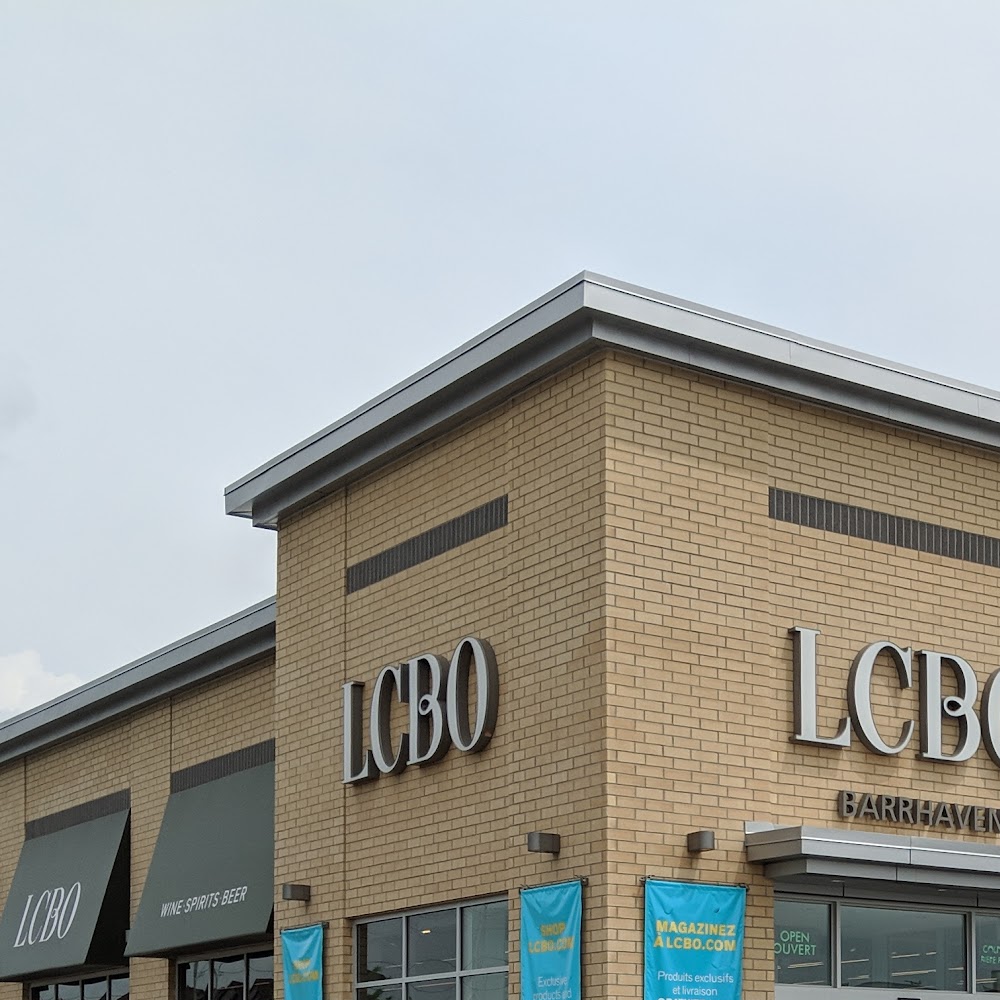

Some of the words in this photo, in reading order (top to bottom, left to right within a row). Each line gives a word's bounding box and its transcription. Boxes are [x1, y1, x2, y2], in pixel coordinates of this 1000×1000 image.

[341, 636, 499, 785] LCBO
[13, 881, 81, 948] LCBO
[541, 922, 566, 936] SHOP
[655, 919, 736, 936] MAGAZINEZ
[653, 931, 664, 948] À
[666, 936, 736, 951] LCBO.COM
[780, 930, 810, 943] OPEN
[774, 942, 817, 956] OUVERT
[657, 970, 693, 983] Produits
[694, 971, 734, 983] exclusifs
[672, 986, 681, 995] et
[682, 985, 718, 996] livraison
